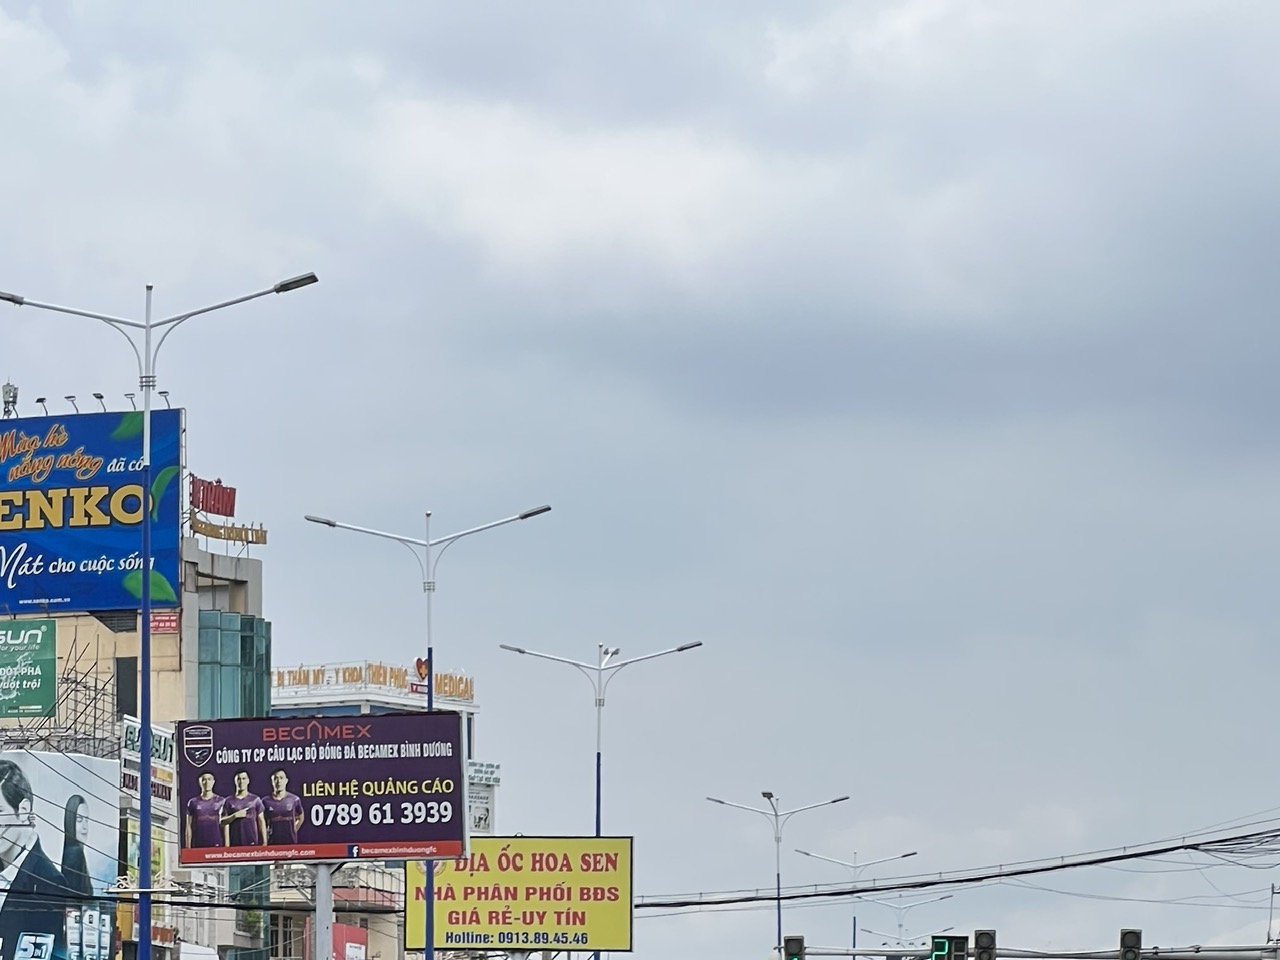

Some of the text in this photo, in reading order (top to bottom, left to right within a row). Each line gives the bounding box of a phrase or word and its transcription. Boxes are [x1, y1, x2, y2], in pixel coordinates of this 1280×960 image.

[44, 424, 69, 449] hè
[106, 457, 126, 473] đã
[48, 558, 76, 573] cho
[79, 555, 114, 575] cuộc
[22, 678, 41, 690] trội
[263, 720, 372, 741] BECAMEX
[216, 740, 452, 765] CÔNG TY CP CÂU LẠC BỘ BÓNG ĐÁ BECAMEX BÌNH DƯƠNG
[302, 776, 454, 798] LIÊN HỆ QUẢNG CÁO
[310, 800, 453, 826] 0789 61 3939
[497, 844, 524, 872] ỐC
[531, 852, 573, 872] HOA
[580, 852, 619, 872] SEN
[464, 883, 518, 901] PHÂN
[525, 881, 572, 901] PHỐI
[579, 886, 619, 901] BĐS
[448, 907, 480, 926] GIÁ
[554, 907, 586, 926] TÍN
[498, 931, 588, 944] 0913.89.45.46
